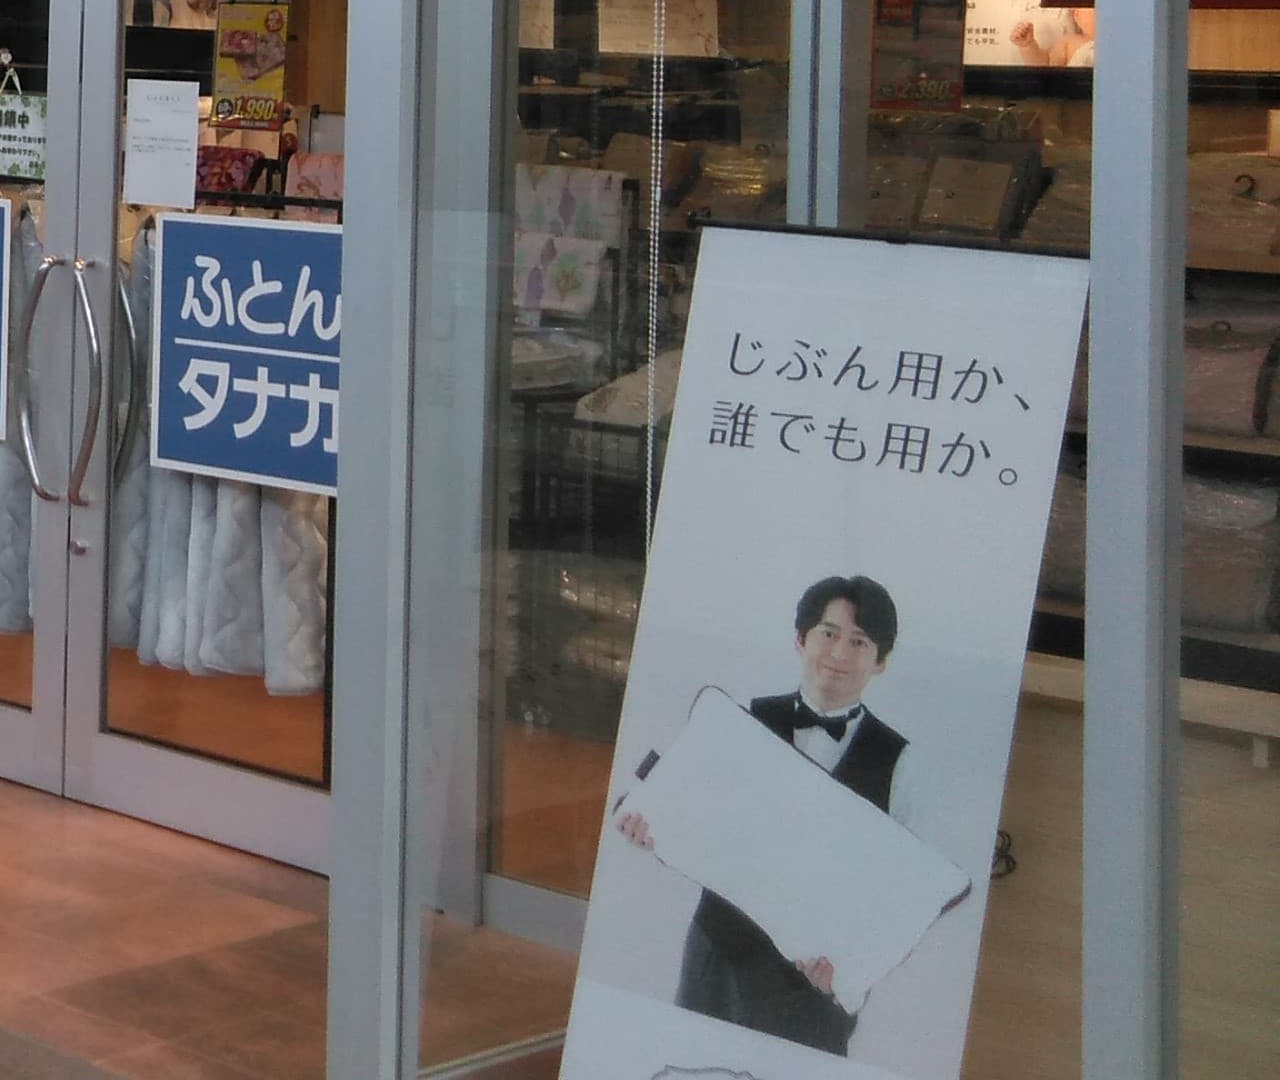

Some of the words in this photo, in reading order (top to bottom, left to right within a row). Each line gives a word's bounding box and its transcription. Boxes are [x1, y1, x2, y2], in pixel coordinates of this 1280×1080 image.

[180, 254, 342, 340] ふとん
[176, 356, 340, 454] タナカ
[725, 330, 1032, 412] じぶん用か、
[706, 399, 1020, 488] 誰でも用か。
